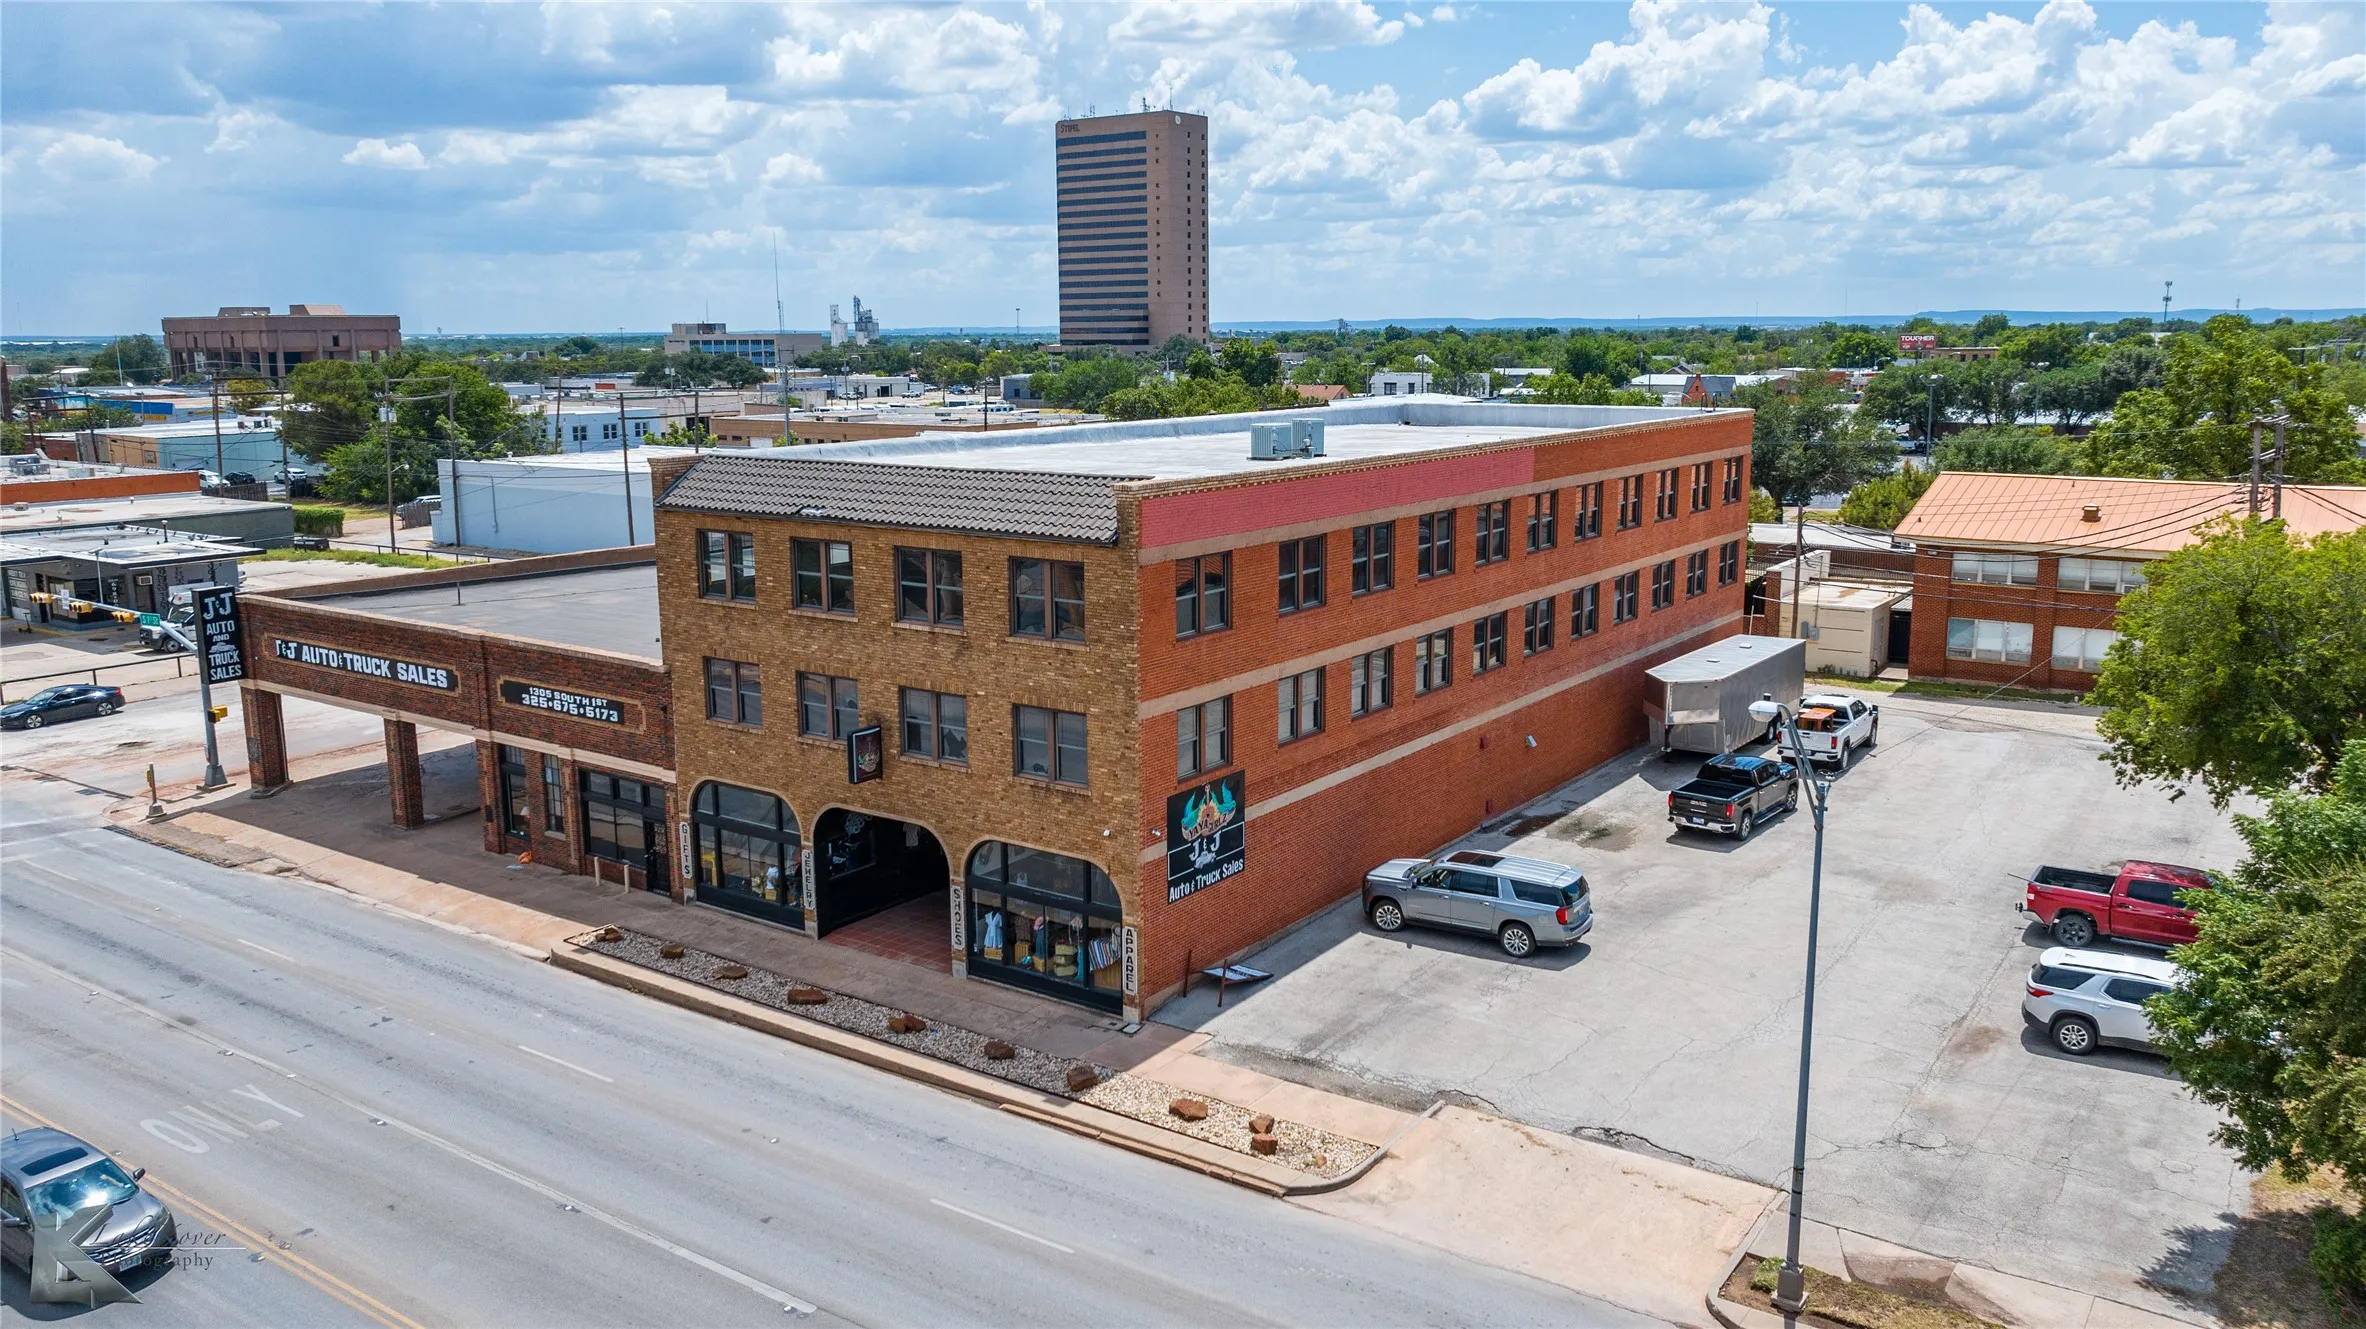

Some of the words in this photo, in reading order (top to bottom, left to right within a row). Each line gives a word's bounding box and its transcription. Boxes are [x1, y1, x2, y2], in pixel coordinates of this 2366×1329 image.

[203, 592, 232, 620] J&J
[207, 620, 235, 636] AUTO
[212, 634, 230, 642] AND
[208, 650, 240, 666] TRUCK
[210, 665, 242, 680] SALES
[397, 662, 448, 688] SALES
[529, 687, 552, 698] 1305
[554, 691, 590, 706] SOUTH
[592, 698, 608, 706] 1ST
[681, 824, 691, 875] GIFTS
[804, 851, 814, 908] JEWELRY
[1169, 883, 1190, 903] Auto
[1222, 858, 1244, 878] Sales
[953, 888, 962, 946] SHOES
[1125, 928, 1135, 992] APPAREL
[140, 1084, 305, 1154] ONLY
